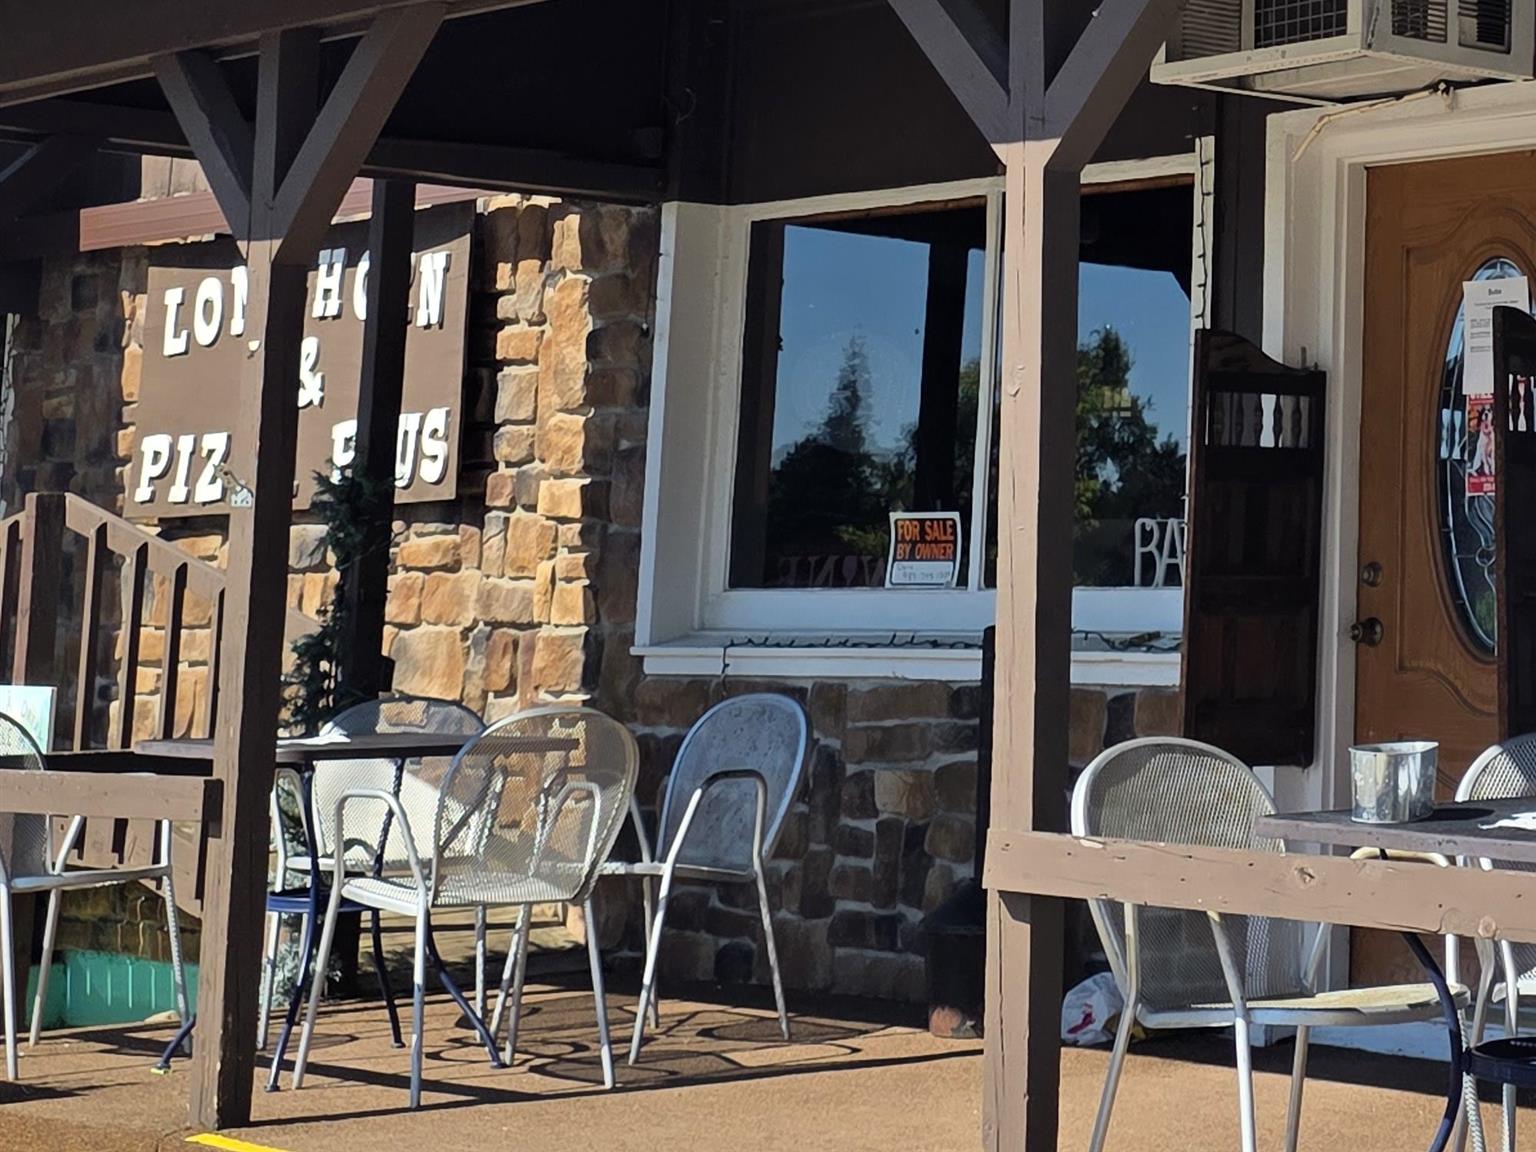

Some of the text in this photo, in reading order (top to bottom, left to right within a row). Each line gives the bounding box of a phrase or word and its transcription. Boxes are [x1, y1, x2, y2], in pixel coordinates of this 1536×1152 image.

[331, 407, 450, 487] PUS
[897, 520, 954, 541] FOR SALE
[896, 543, 953, 560] BY OWNER
